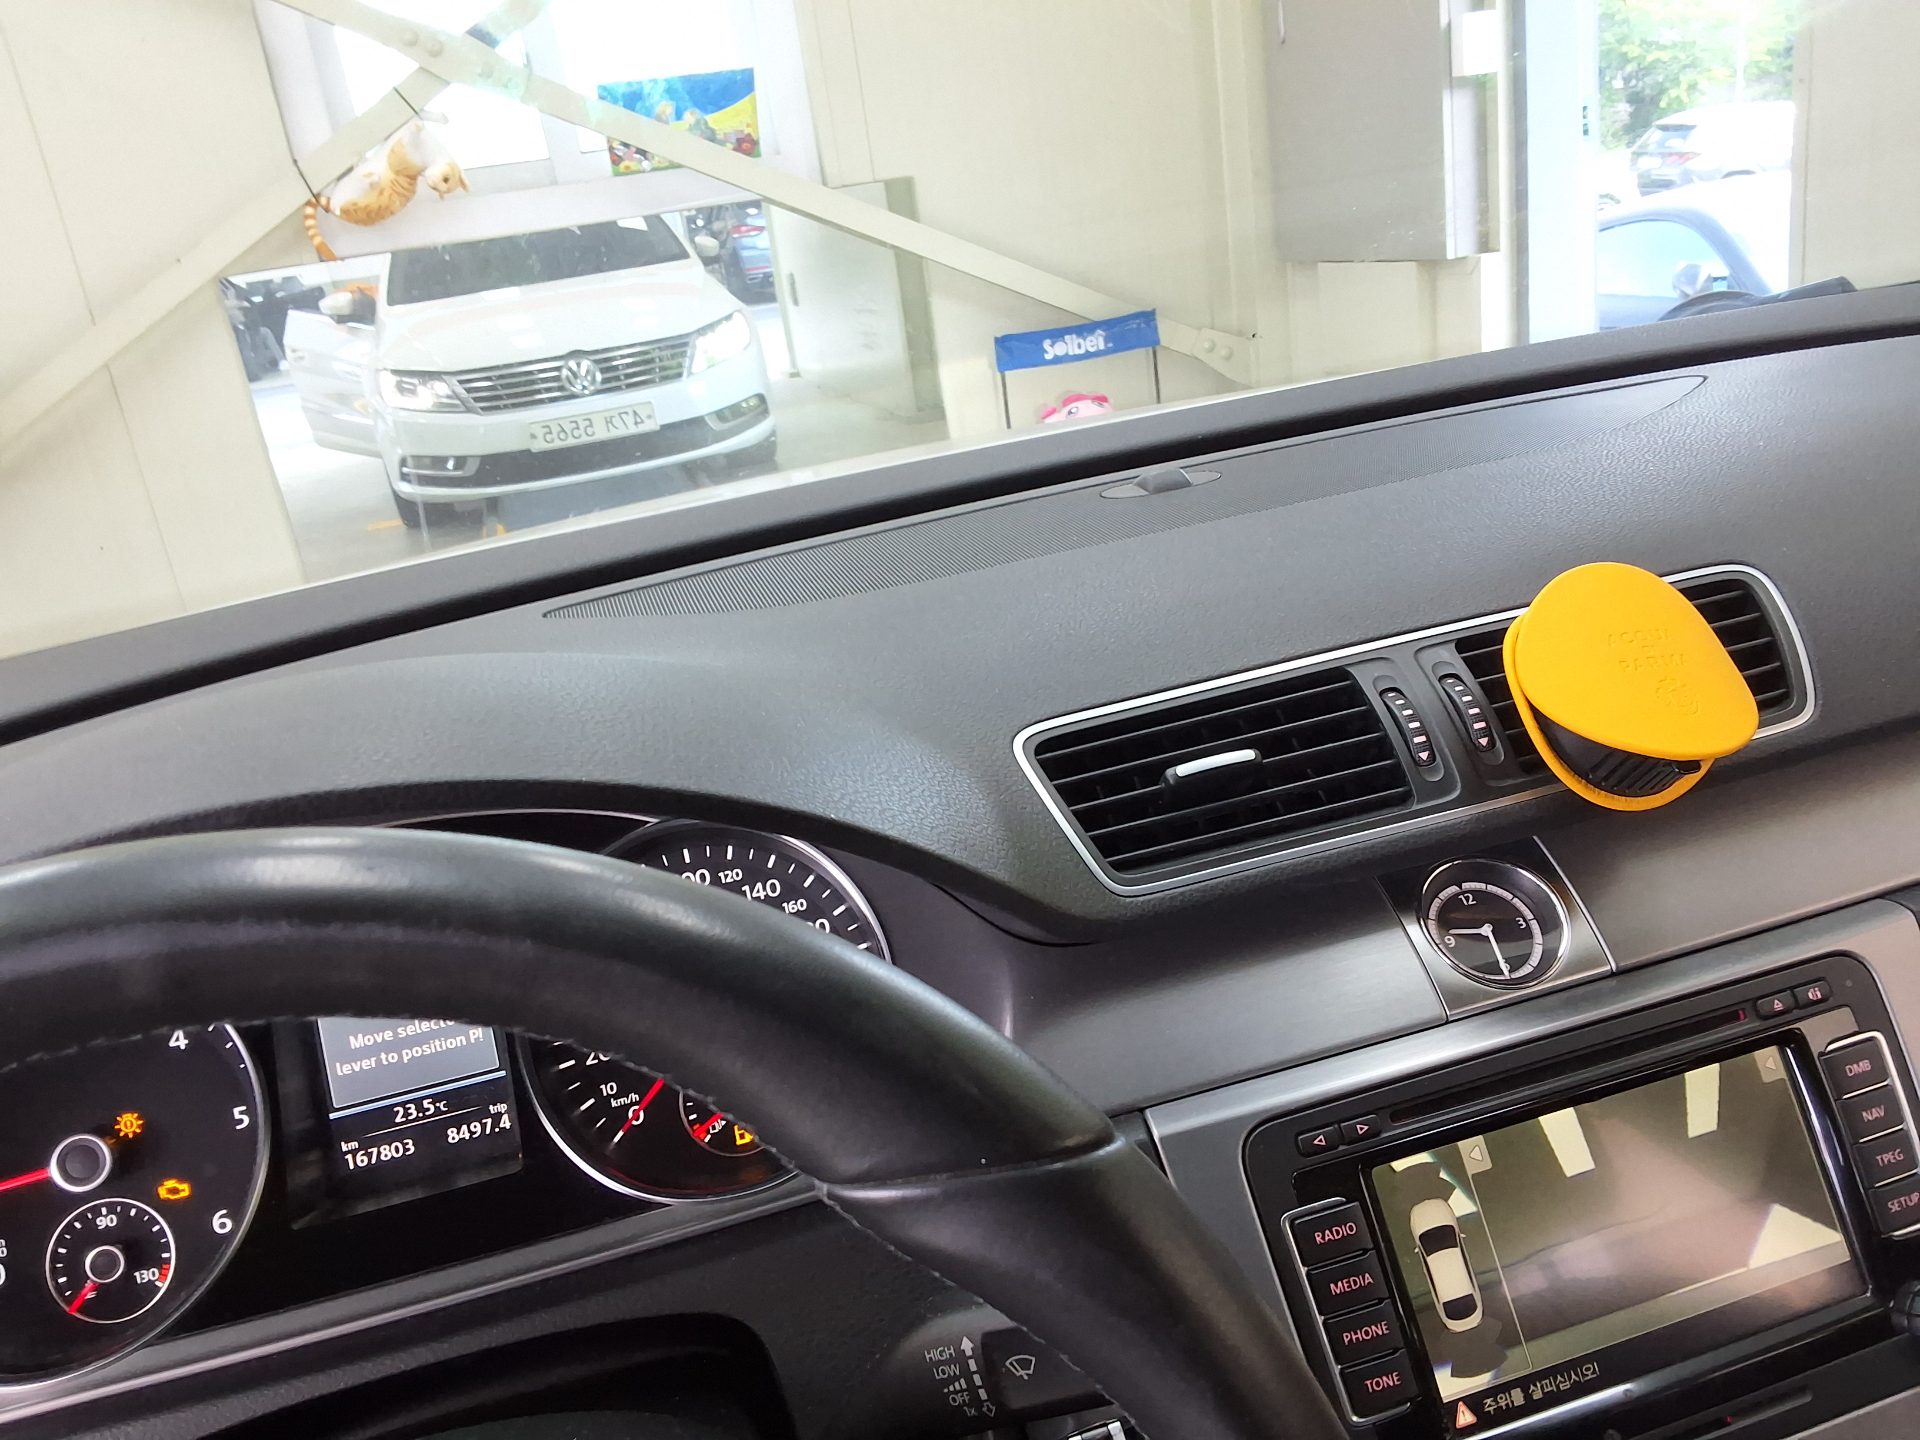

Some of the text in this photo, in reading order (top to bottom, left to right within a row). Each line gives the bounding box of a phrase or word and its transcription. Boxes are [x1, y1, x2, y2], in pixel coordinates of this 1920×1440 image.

[718, 868, 742, 884] 120
[742, 879, 780, 900] 140
[782, 898, 807, 914] 160
[1458, 893, 1477, 906] 12
[1515, 917, 1526, 928] 3
[1444, 936, 1456, 948] 9
[168, 1030, 188, 1050] 4
[349, 1029, 394, 1051] Move
[336, 1027, 484, 1076] lever to position P!
[1845, 1060, 1872, 1076] DMB
[599, 1082, 617, 1097] 10
[488, 1102, 508, 1116] trip
[611, 1093, 639, 1109] km/h
[233, 1105, 250, 1129] 5
[628, 1105, 644, 1125] 0
[1862, 1105, 1885, 1123] NAV
[446, 1113, 512, 1145] 8497.4
[341, 1140, 358, 1153] km
[345, 1139, 415, 1170] 167803
[1875, 1149, 1904, 1167] TPEG
[1887, 1192, 1920, 1213] SETUP
[96, 1214, 117, 1230] 90
[212, 1209, 232, 1234] 6
[1314, 1222, 1357, 1245] RADIO
[134, 1267, 159, 1284] 130
[1330, 1273, 1374, 1296] MEDIA
[1343, 1321, 1390, 1345] PHONE
[925, 1345, 955, 1363] HIGH
[933, 1363, 960, 1380] LOW
[1364, 1371, 1401, 1393] TONE
[949, 1392, 970, 1406] OFF
[963, 1405, 978, 1417] 1x
